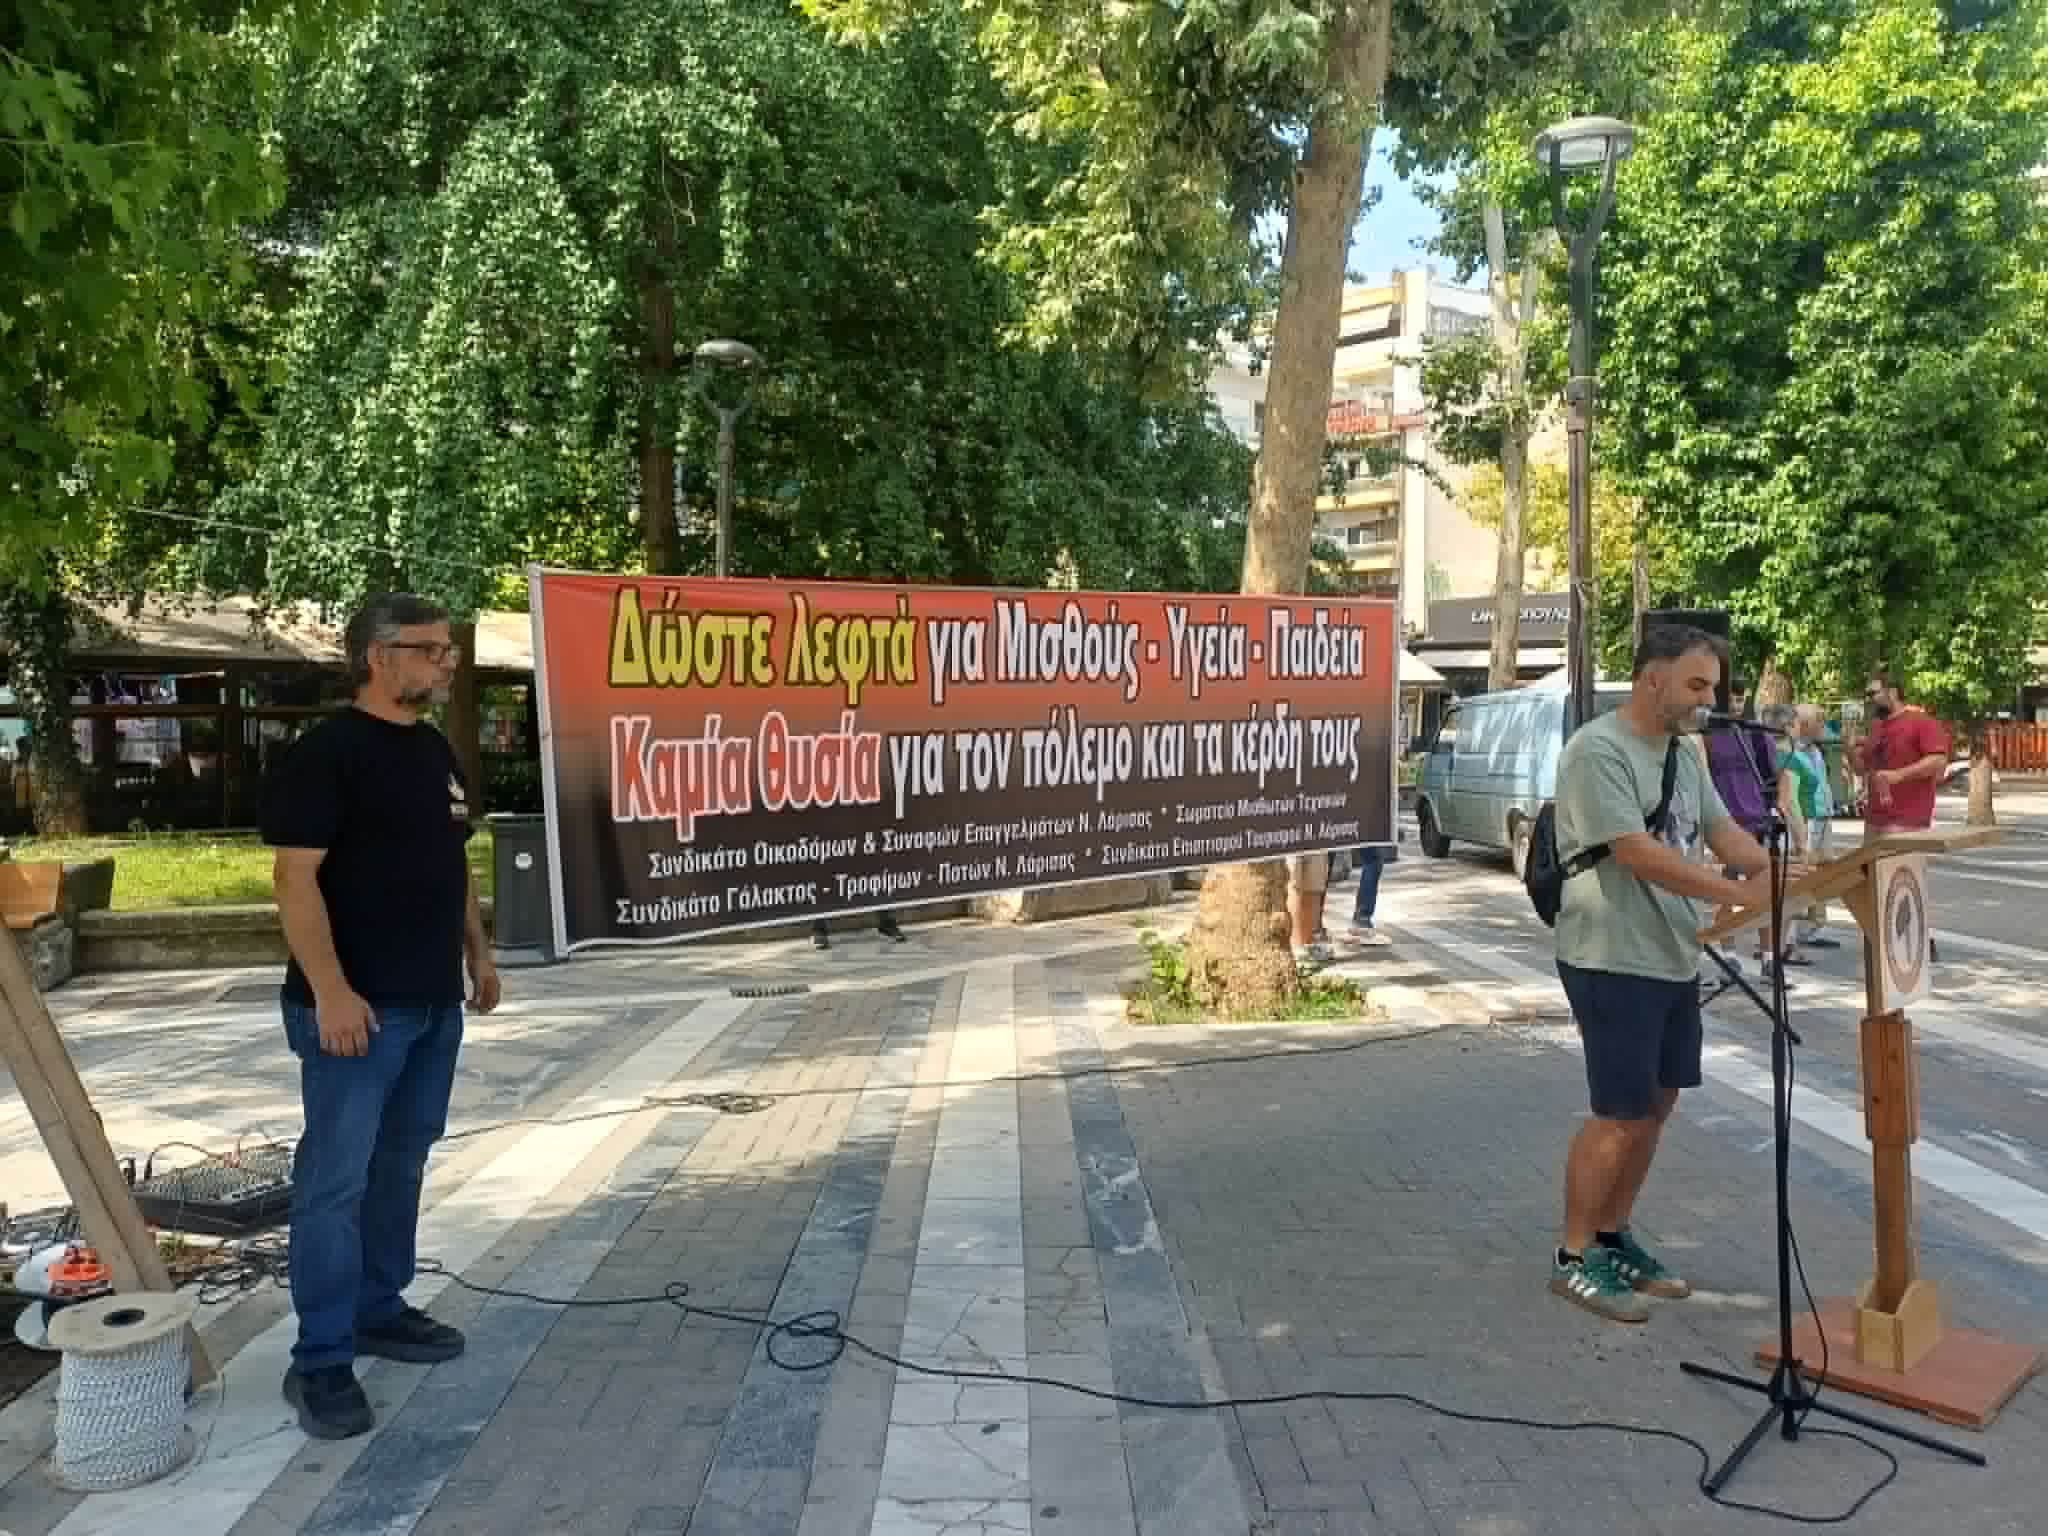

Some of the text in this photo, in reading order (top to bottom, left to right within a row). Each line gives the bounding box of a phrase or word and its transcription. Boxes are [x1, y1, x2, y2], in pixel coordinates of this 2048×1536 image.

[609, 585, 776, 688] Δώστε
[785, 591, 917, 706] λεφτά
[927, 616, 986, 704] για
[996, 600, 1140, 700] Μισθούς
[1164, 602, 1248, 697] Υγεία
[1269, 608, 1367, 678] Παιδεία
[610, 714, 751, 841] Καμία
[889, 735, 945, 819] για
[954, 730, 1011, 792] τον
[1022, 706, 1132, 800] πόλεμο
[1142, 722, 1185, 778] και
[1194, 724, 1224, 774] τα
[1232, 703, 1301, 788] κέρδη
[1310, 718, 1361, 783] τους
[616, 893, 720, 925] Συνδικάτο
[727, 882, 817, 912] Γάλακτος
[835, 868, 921, 900] Τροφίμων
[938, 860, 993, 885] Ποτών
[648, 850, 747, 879] Συνδικάτο
[754, 836, 857, 866] Οικοδόμων
[863, 832, 875, 855] &
[881, 824, 960, 854] Συναφών
[965, 816, 1074, 845] Επαγγελμάτων
